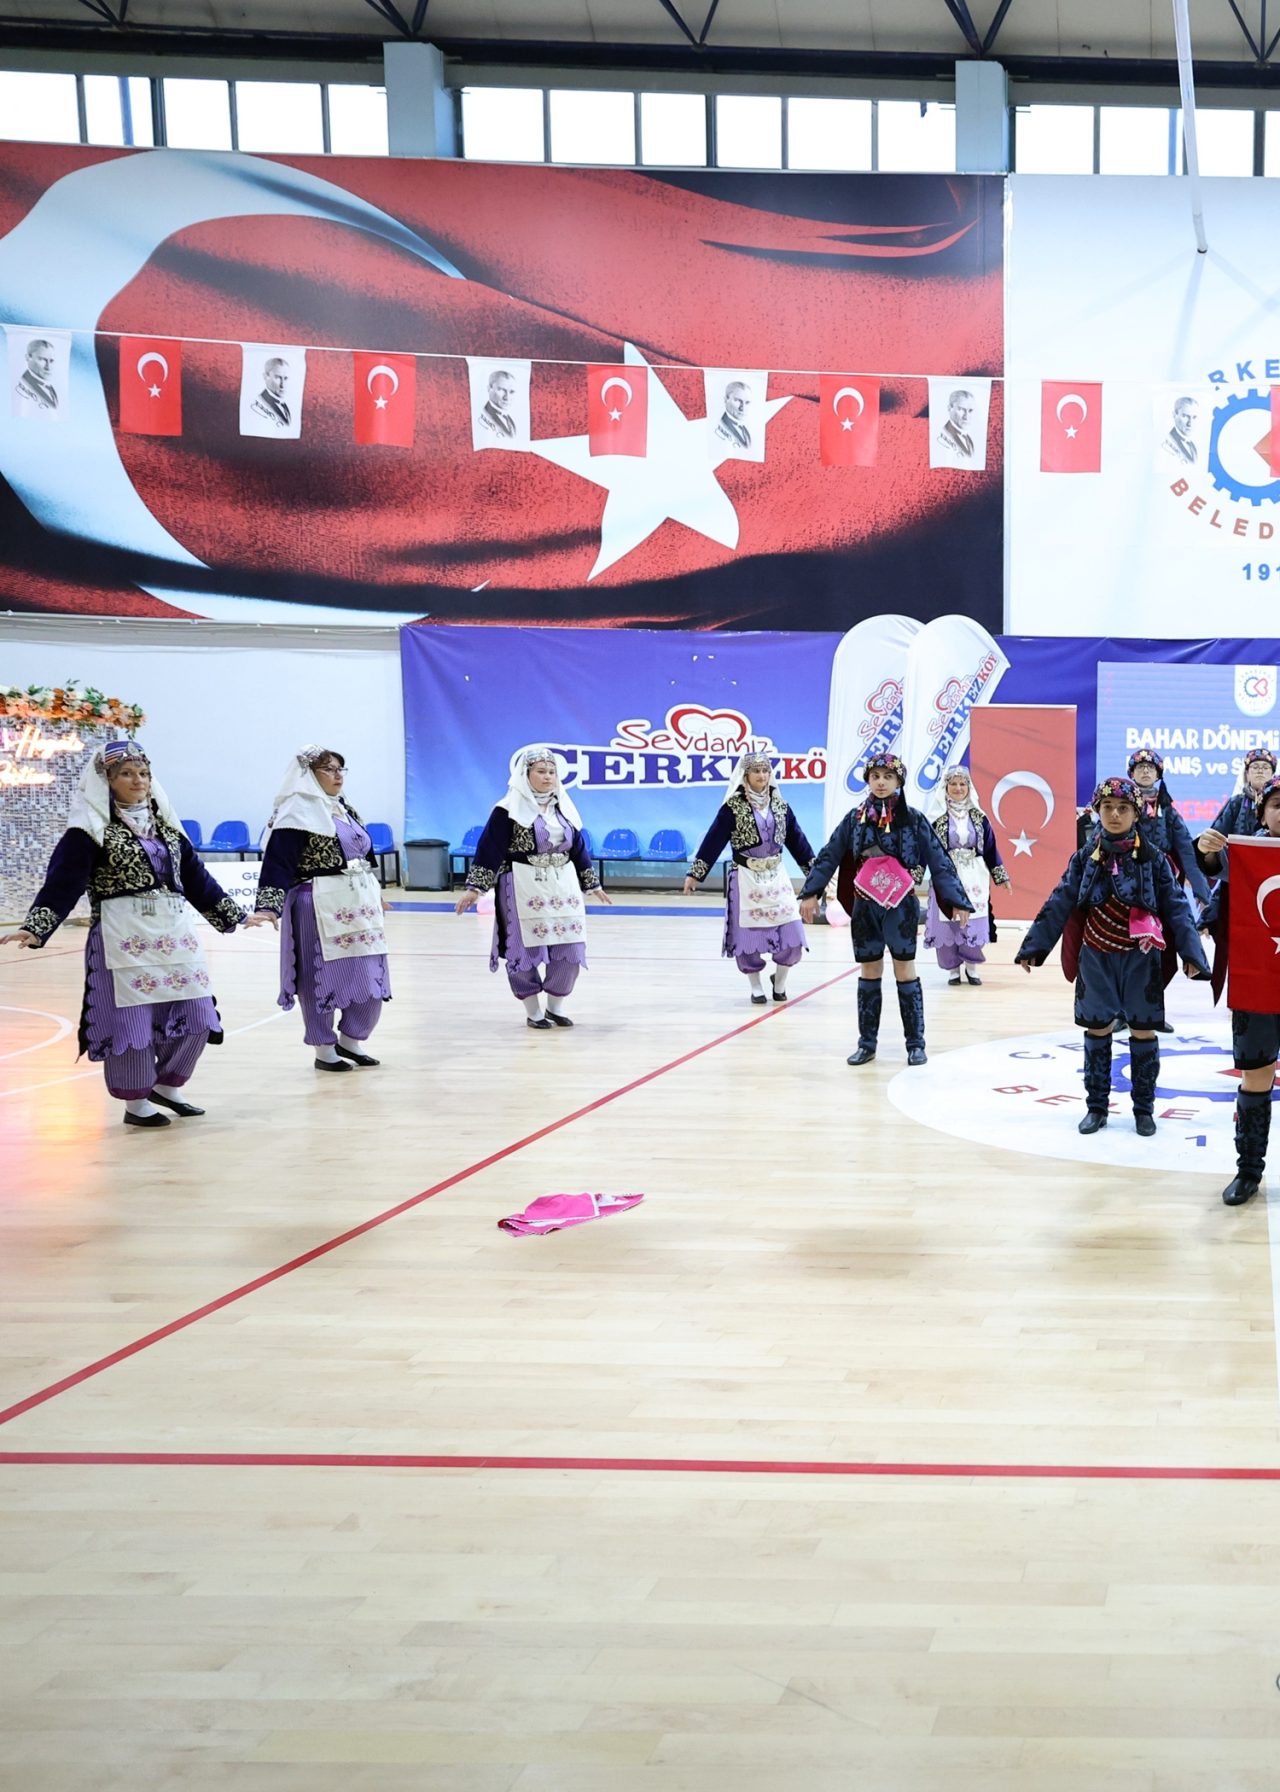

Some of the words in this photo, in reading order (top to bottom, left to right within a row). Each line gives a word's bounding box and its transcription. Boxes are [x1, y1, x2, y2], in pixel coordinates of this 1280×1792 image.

[615, 723, 774, 754] Sevdamız
[1126, 727, 1200, 750] BAHAR
[1205, 762, 1229, 775] ve
